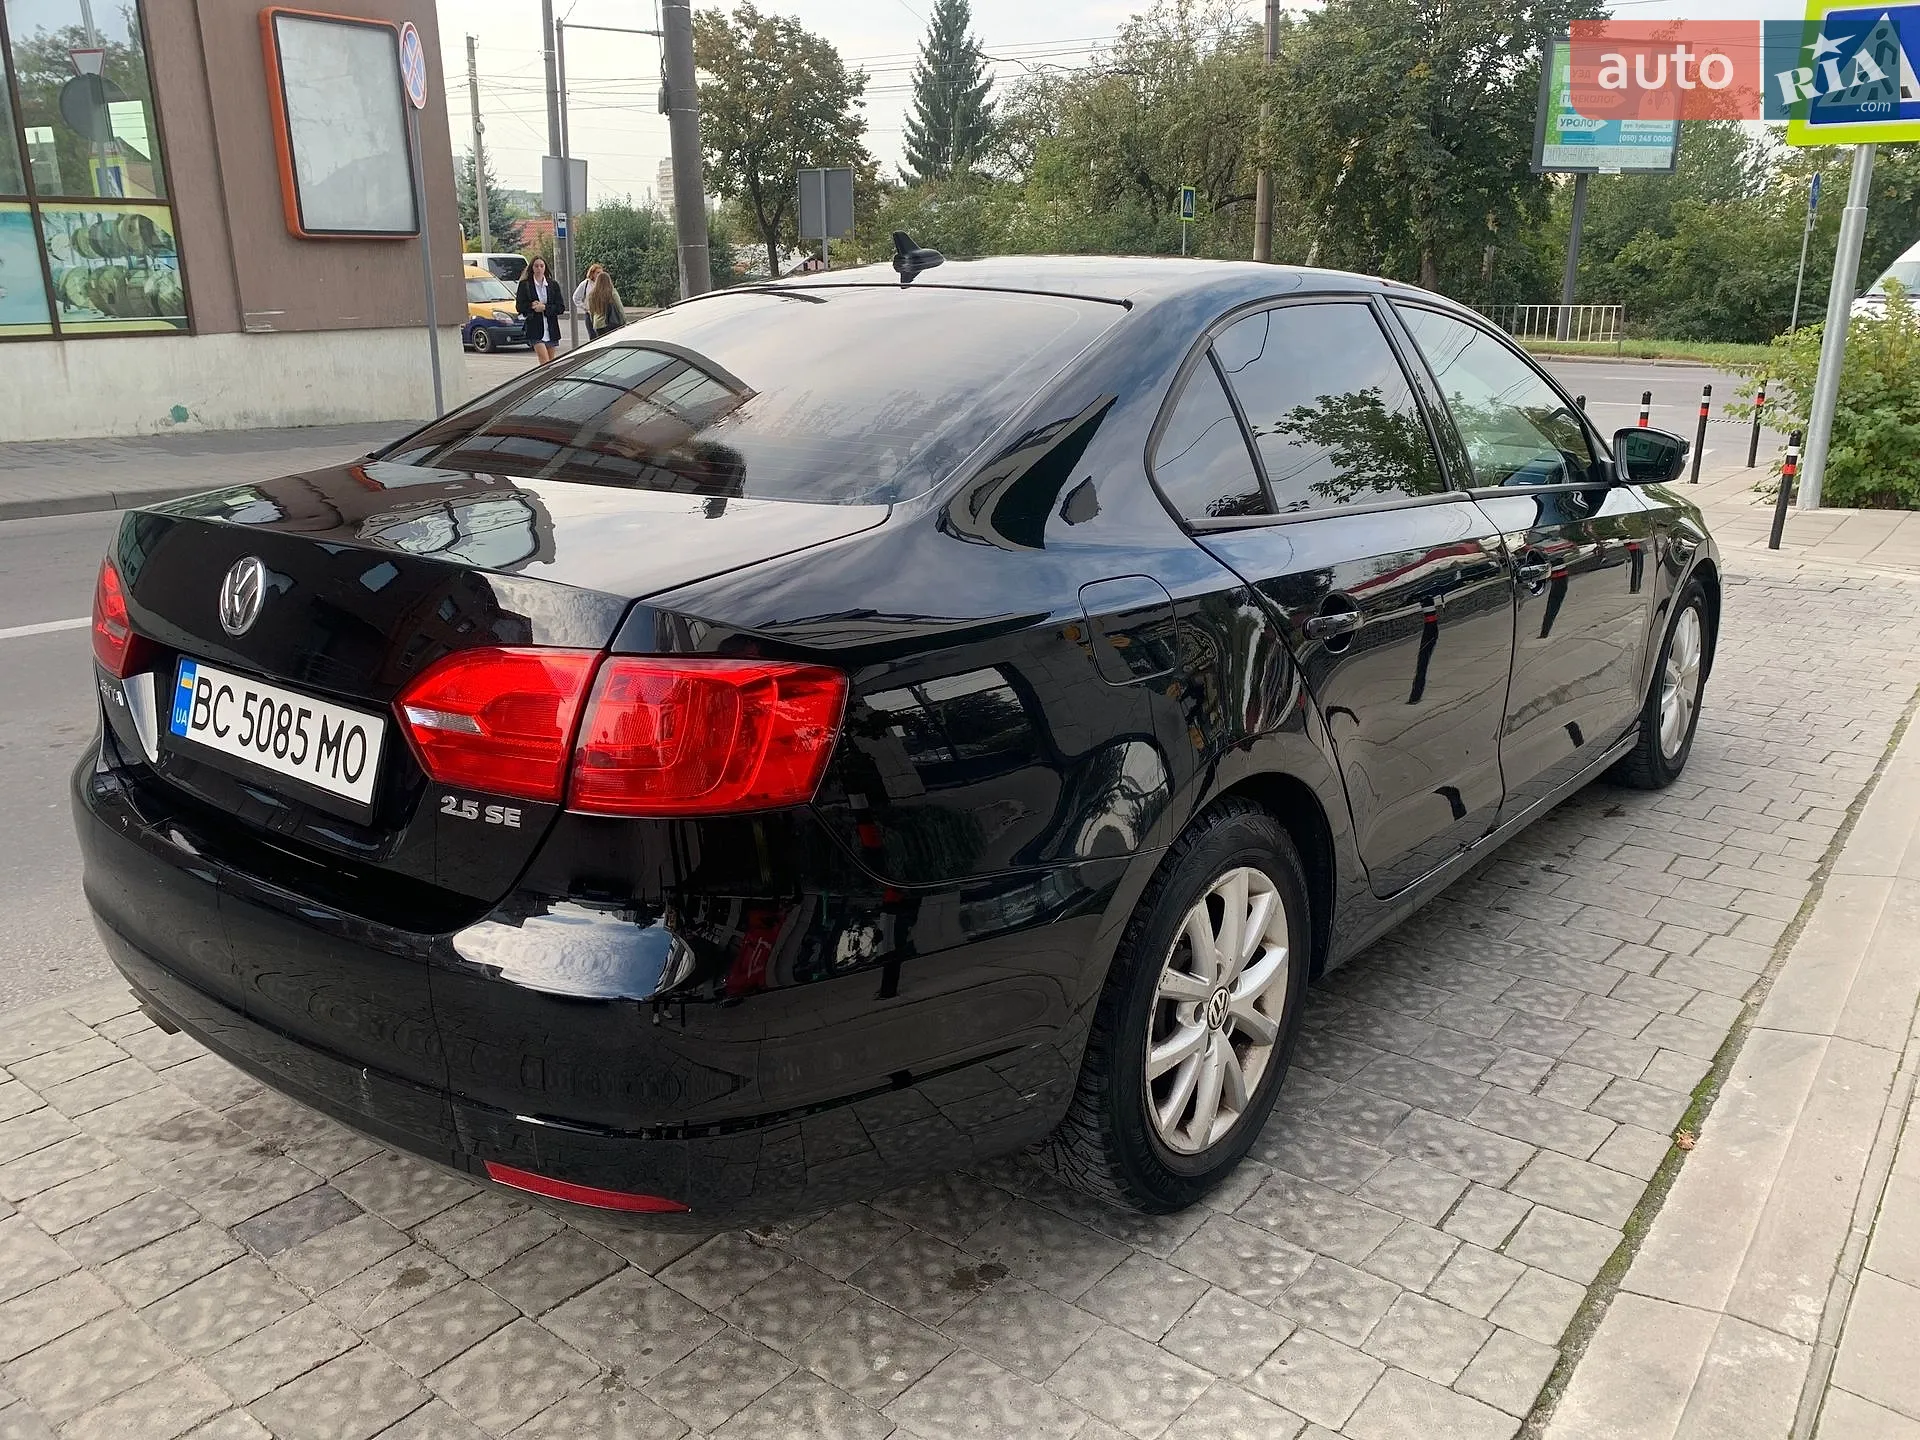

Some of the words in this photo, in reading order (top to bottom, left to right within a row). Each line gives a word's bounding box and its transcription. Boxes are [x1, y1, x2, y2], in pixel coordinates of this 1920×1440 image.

[1560, 118, 1600, 128] УРОЛОГ
[175, 708, 188, 724] UA
[191, 676, 235, 739] BC
[238, 691, 312, 766] 5085
[315, 714, 367, 784] MO
[485, 805, 522, 829] SE
